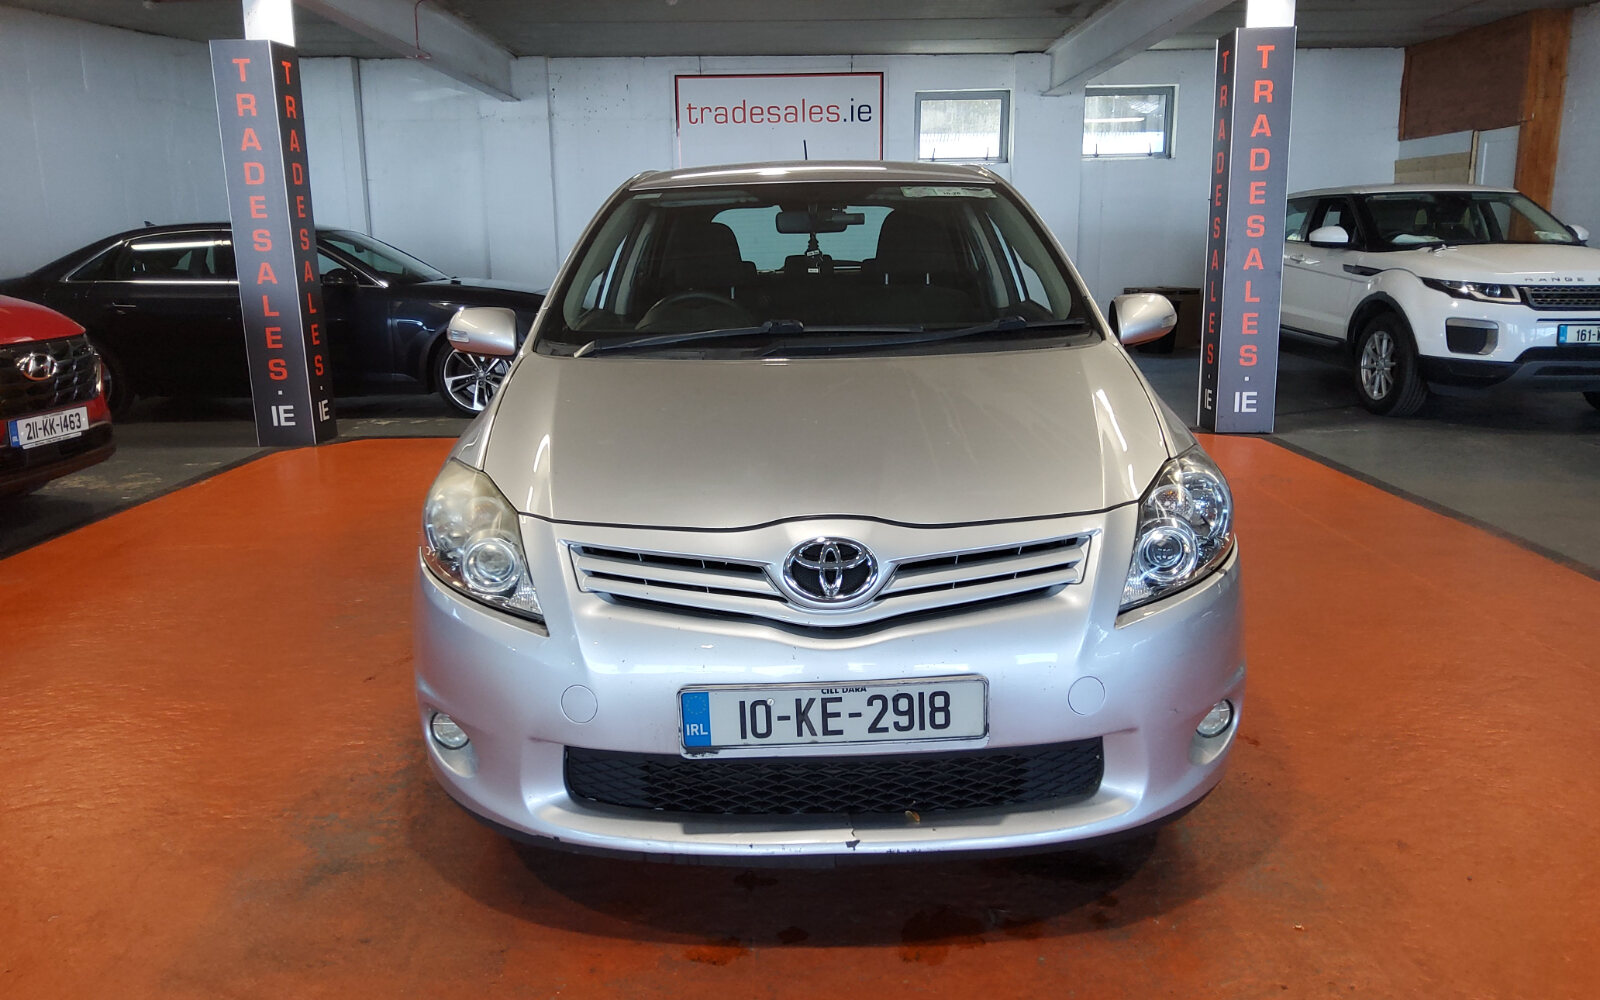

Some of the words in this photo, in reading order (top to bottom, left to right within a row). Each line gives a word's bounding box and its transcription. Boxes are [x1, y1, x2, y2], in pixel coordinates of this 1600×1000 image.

[686, 97, 872, 125] tradesales.ie
[1576, 328, 1600, 342] 161-
[25, 412, 81, 440] 211-KK-1463
[738, 690, 952, 740] 10-KE-2918
[686, 723, 709, 736] IRL
